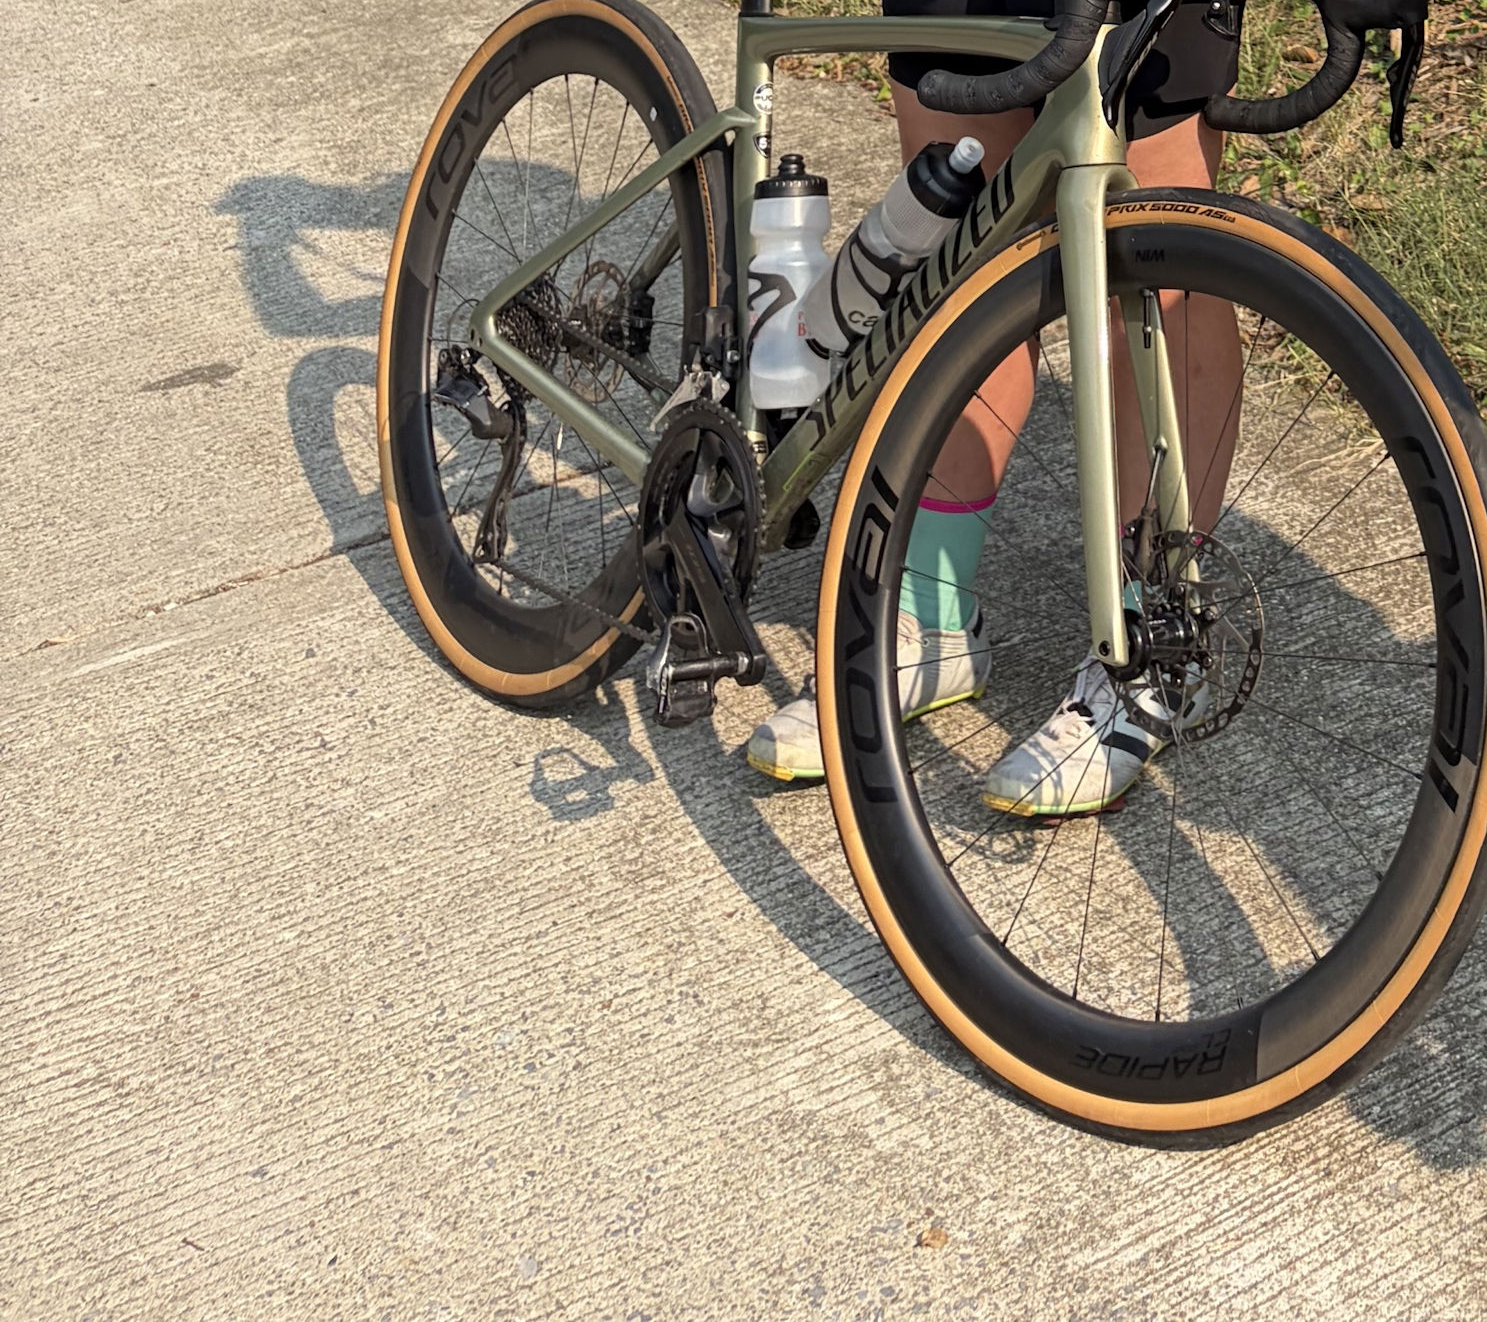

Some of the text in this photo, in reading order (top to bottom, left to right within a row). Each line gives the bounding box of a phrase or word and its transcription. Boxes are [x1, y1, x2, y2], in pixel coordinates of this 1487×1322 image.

[1107, 203, 1149, 216] PRIX
[1149, 203, 1199, 214] 5000
[1198, 209, 1227, 221] AS
[803, 153, 1015, 451] SPECIALIZED
[1068, 1045, 1227, 1080] RAPIDE
